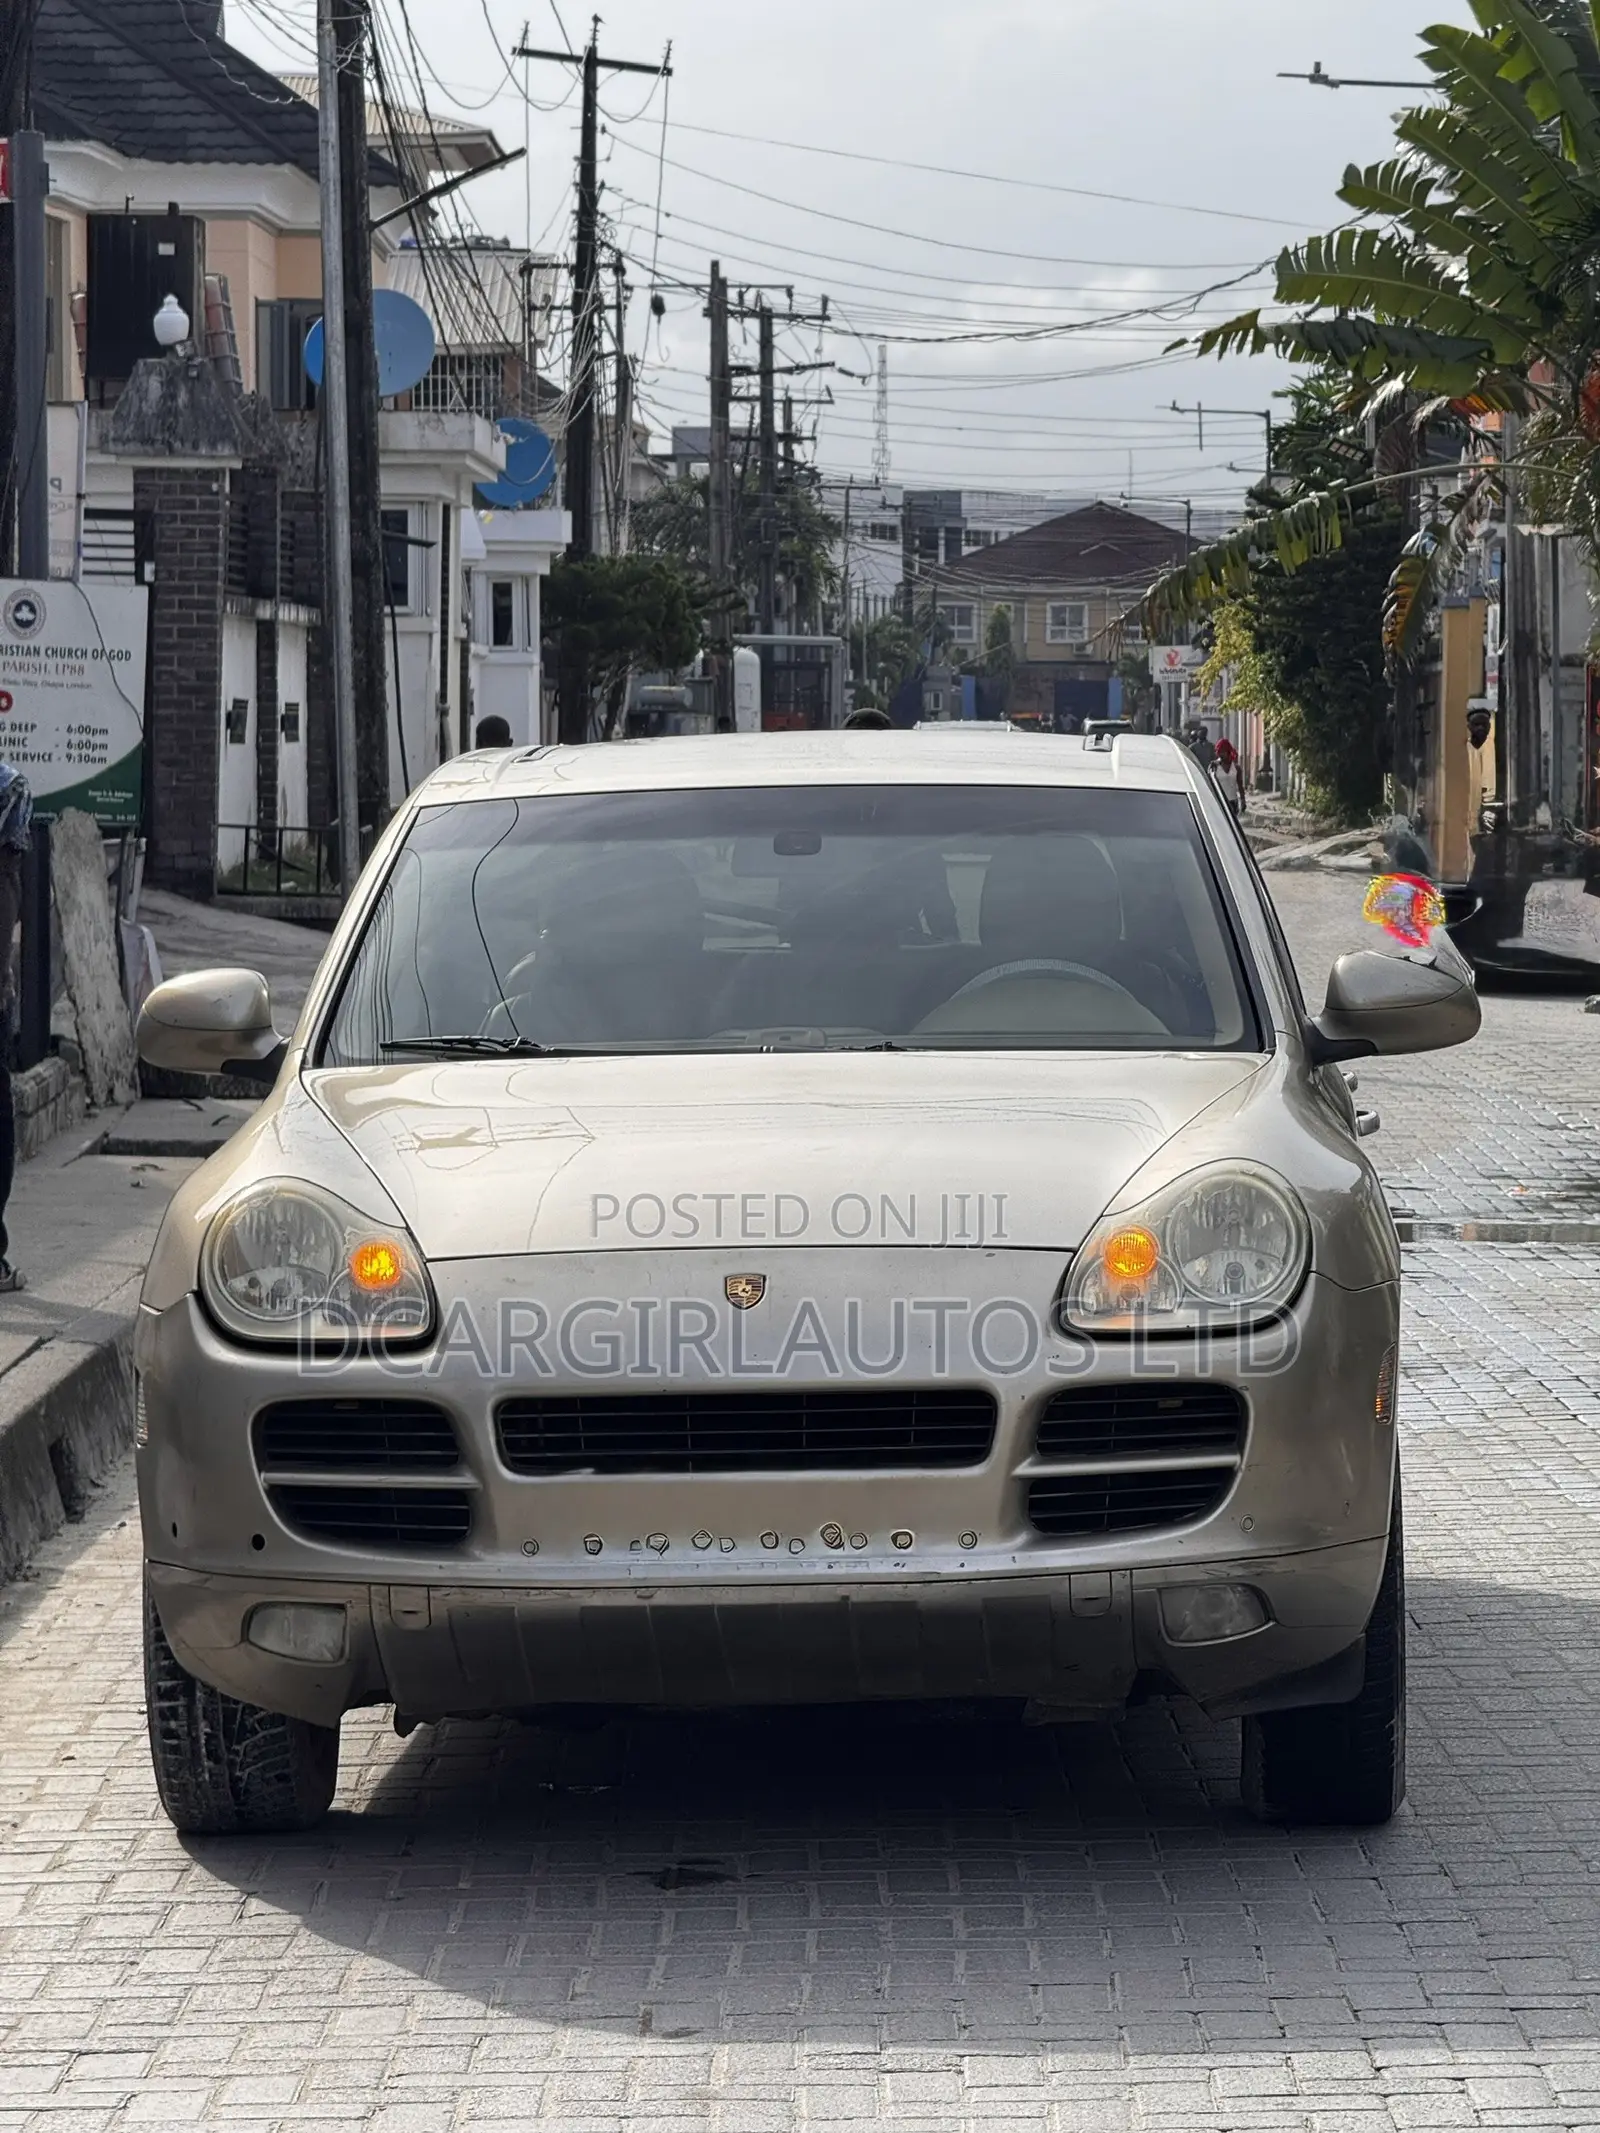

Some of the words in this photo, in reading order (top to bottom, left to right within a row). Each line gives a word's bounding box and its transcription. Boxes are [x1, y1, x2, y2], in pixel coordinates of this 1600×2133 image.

[45, 646, 88, 659] CHURCH
[108, 649, 131, 661] GOD
[10, 722, 37, 733] DEEP
[66, 724, 109, 737] 6:00pm
[66, 739, 109, 752] 6:00pm
[10, 751, 53, 763] SERVICE
[65, 752, 107, 764] 9:30am
